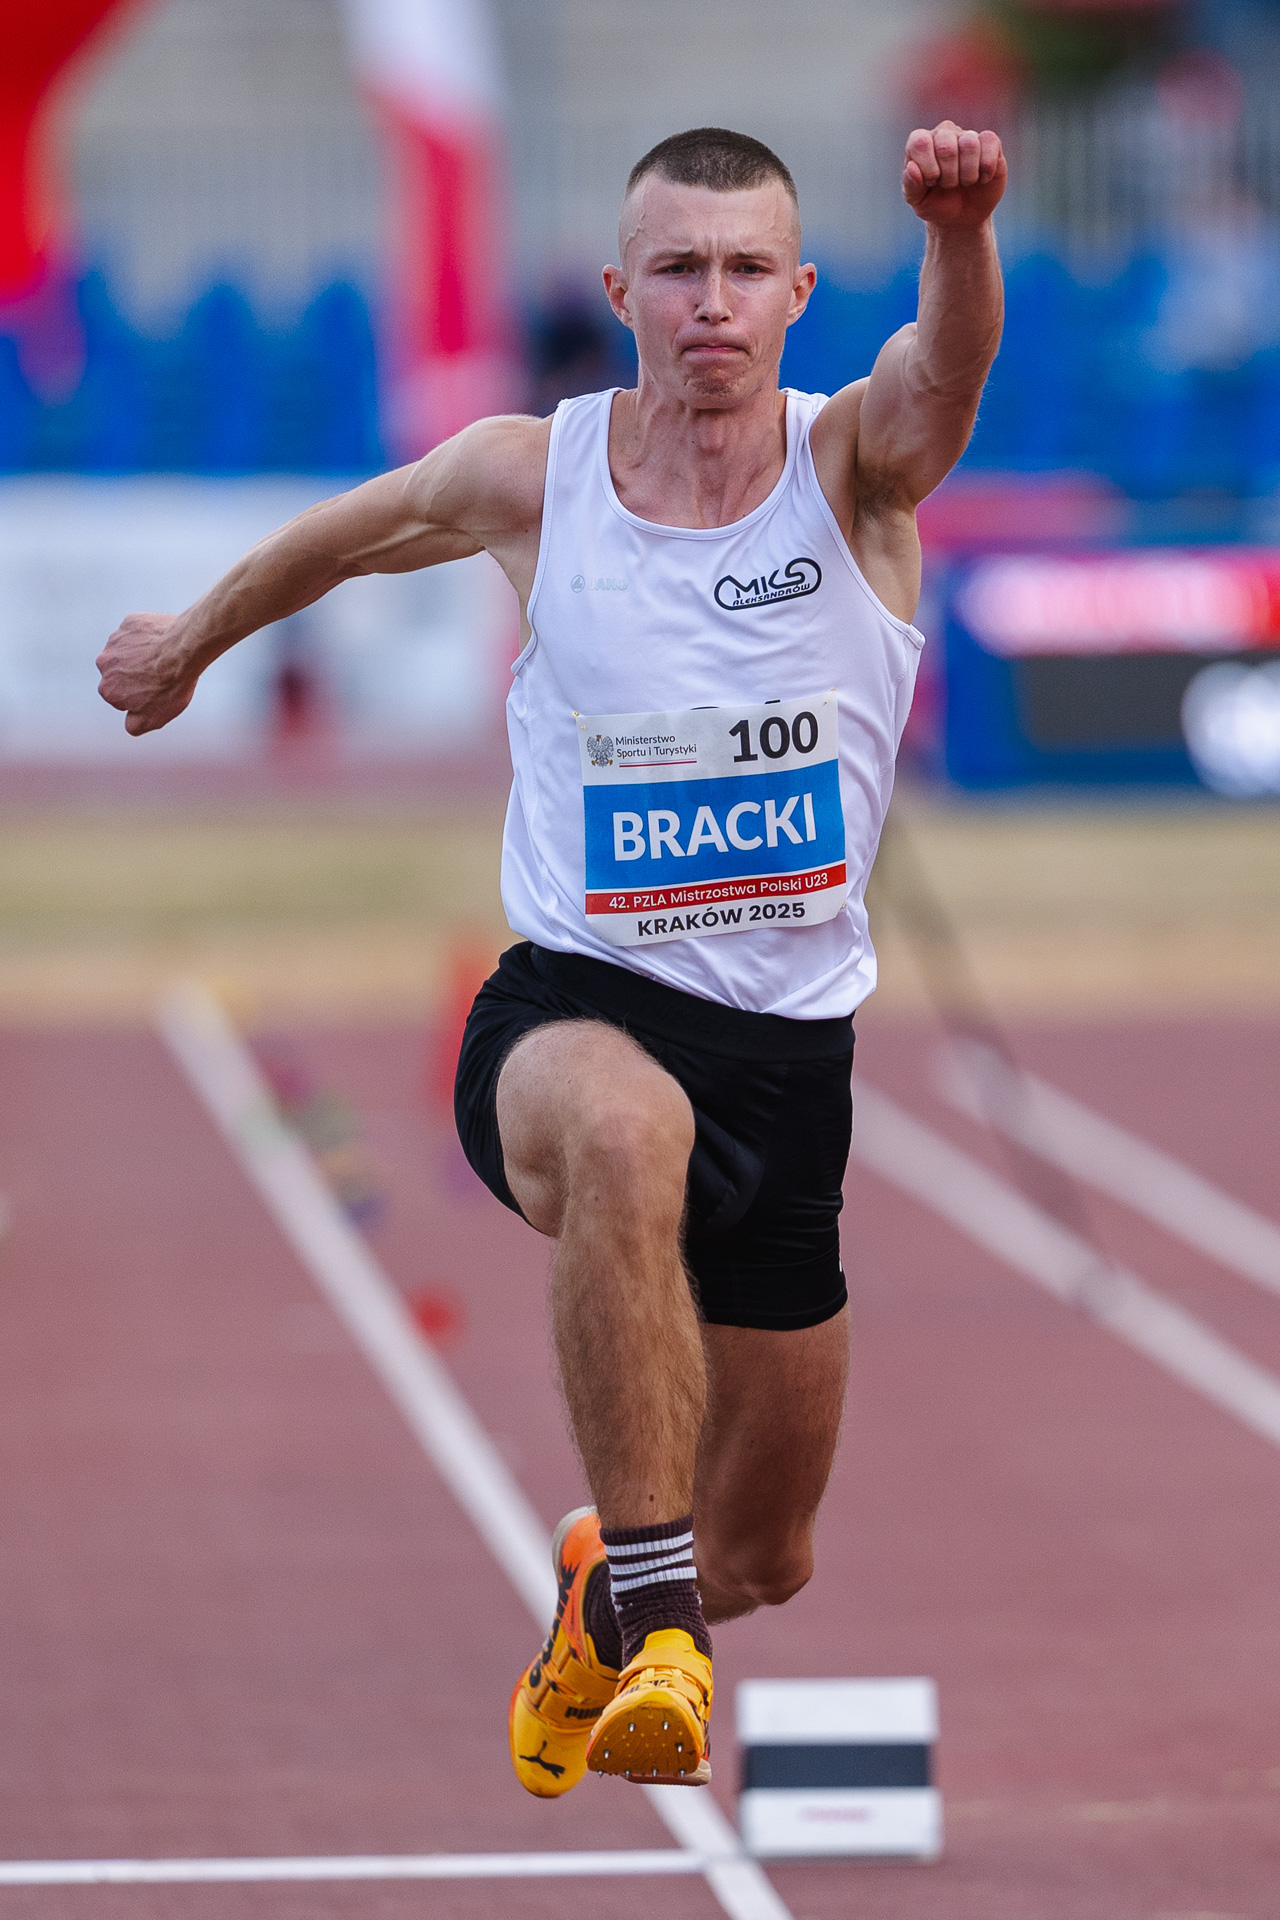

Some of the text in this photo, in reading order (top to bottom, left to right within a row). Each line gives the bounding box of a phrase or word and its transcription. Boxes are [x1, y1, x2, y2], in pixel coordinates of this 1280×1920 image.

[732, 583, 811, 607] ALEKSANDRÓW
[615, 735, 676, 746] Ministerstwo
[616, 743, 698, 759] Sportu i Turystyki
[728, 711, 819, 763] 100
[612, 792, 817, 862] BRACKI
[608, 872, 829, 909] 42. PZLA Mistrzostwa Polski U23
[637, 901, 807, 937] KRAKÓW 2025
